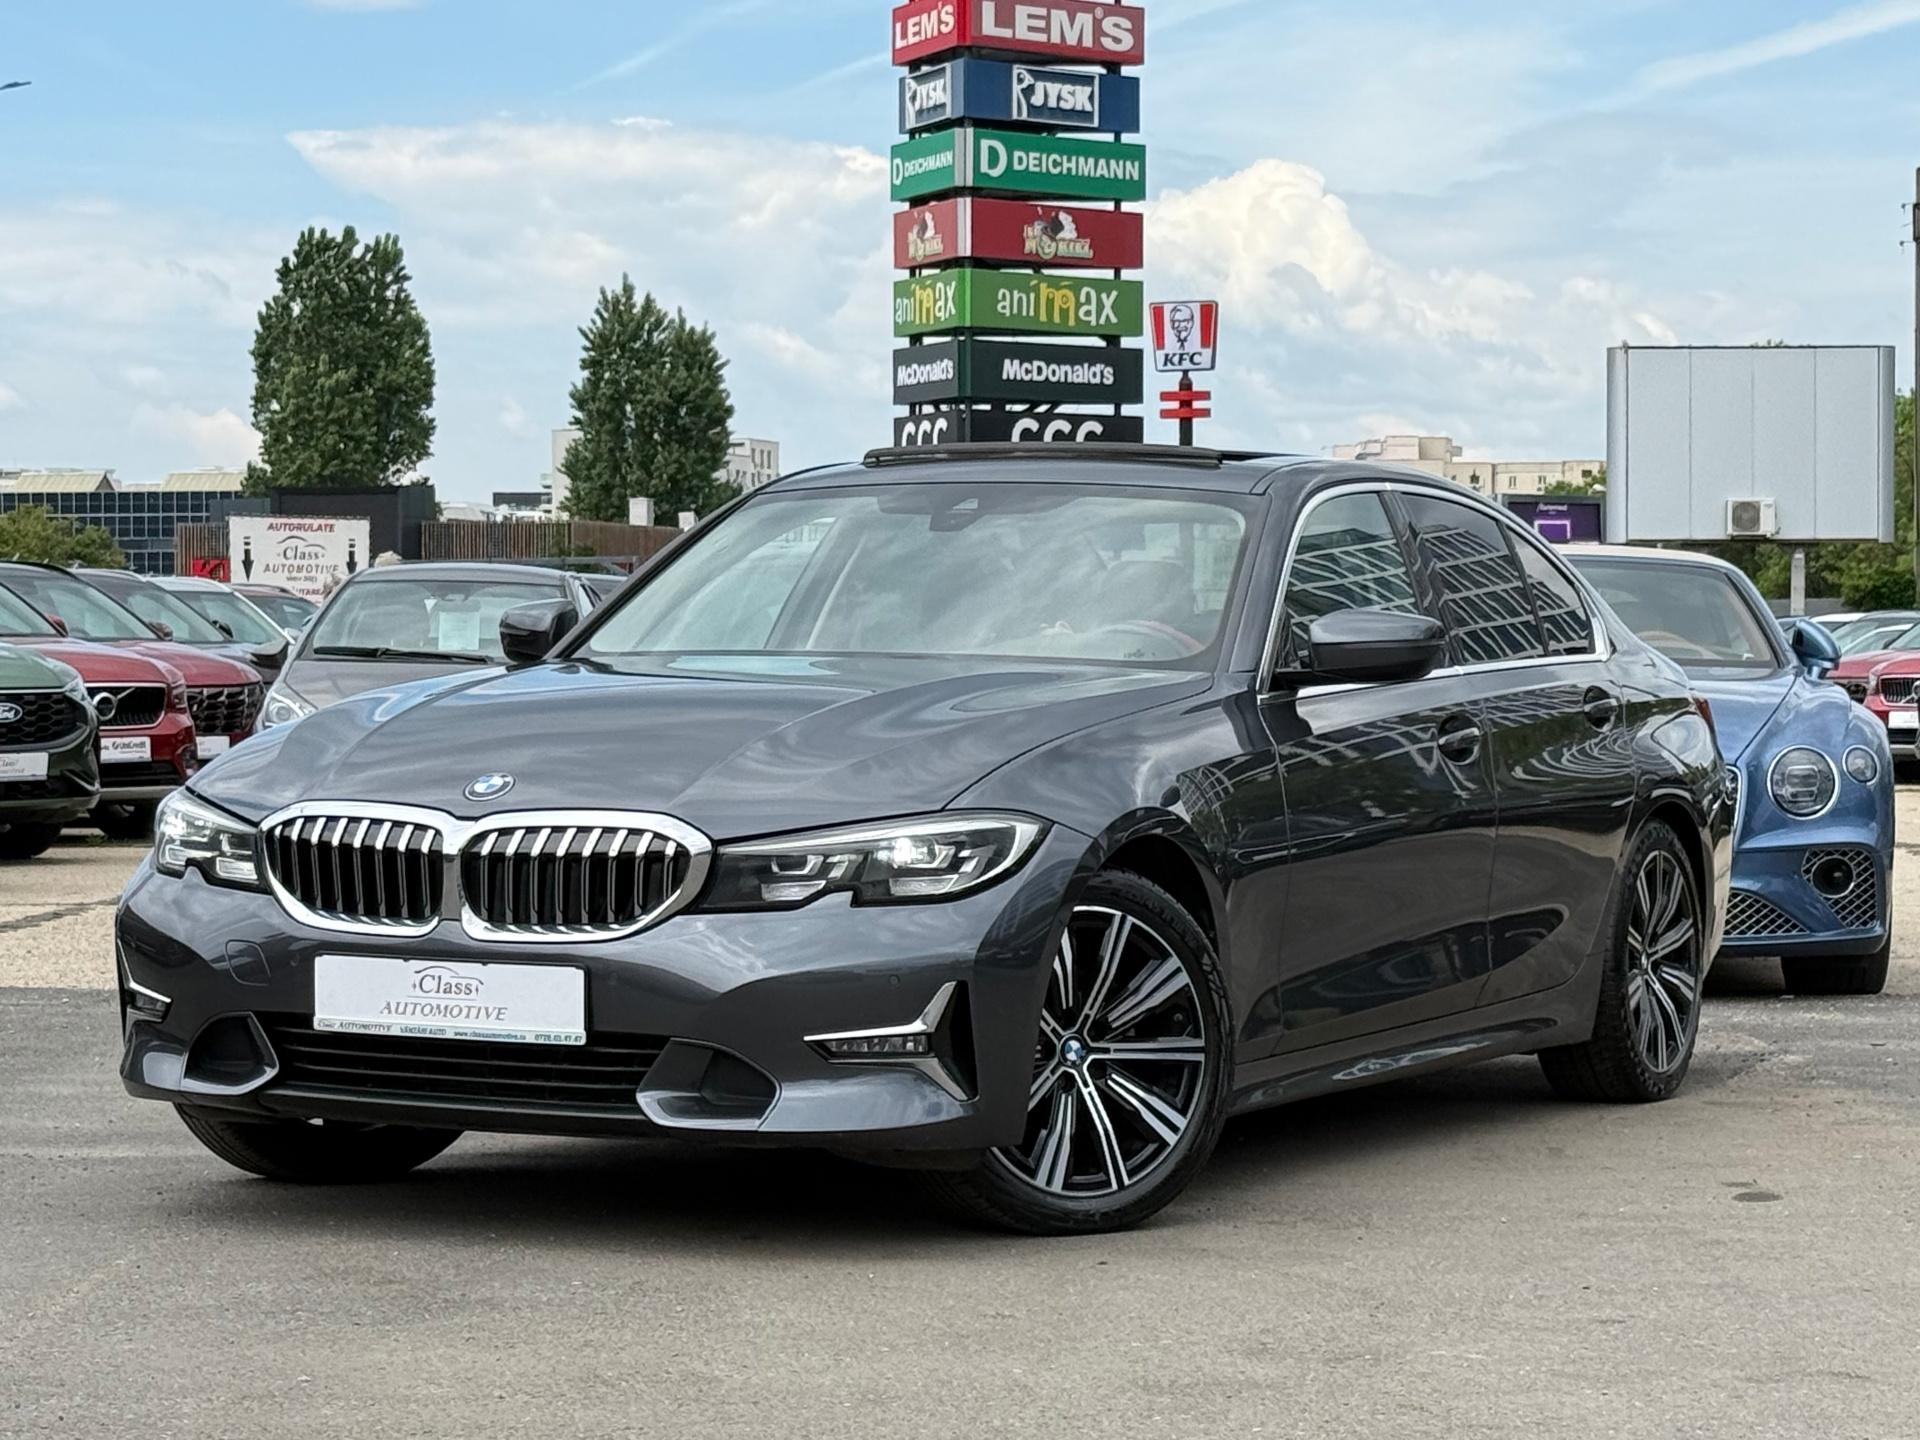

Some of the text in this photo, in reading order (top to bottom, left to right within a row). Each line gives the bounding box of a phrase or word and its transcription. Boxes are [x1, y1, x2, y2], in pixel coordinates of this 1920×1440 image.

[895, 4, 955, 49] LEM'S
[982, 1, 1134, 52] LEM'S
[914, 78, 946, 111] JYSK
[1030, 80, 1093, 112] JYSK
[904, 150, 953, 177] DEICHMANN
[1013, 151, 1140, 180] DEICHMANN
[895, 280, 956, 325] animax
[996, 279, 1119, 326] animax
[896, 358, 954, 387] McDonald's
[1002, 358, 1115, 385] McDonald's
[1162, 352, 1203, 368] KFC
[266, 522, 336, 533] AUTORULATE
[282, 545, 320, 561] Class
[263, 563, 339, 574] AUTOMOTIVE
[419, 974, 473, 997] Class
[379, 1000, 508, 1022] AUTOMOTIVE
